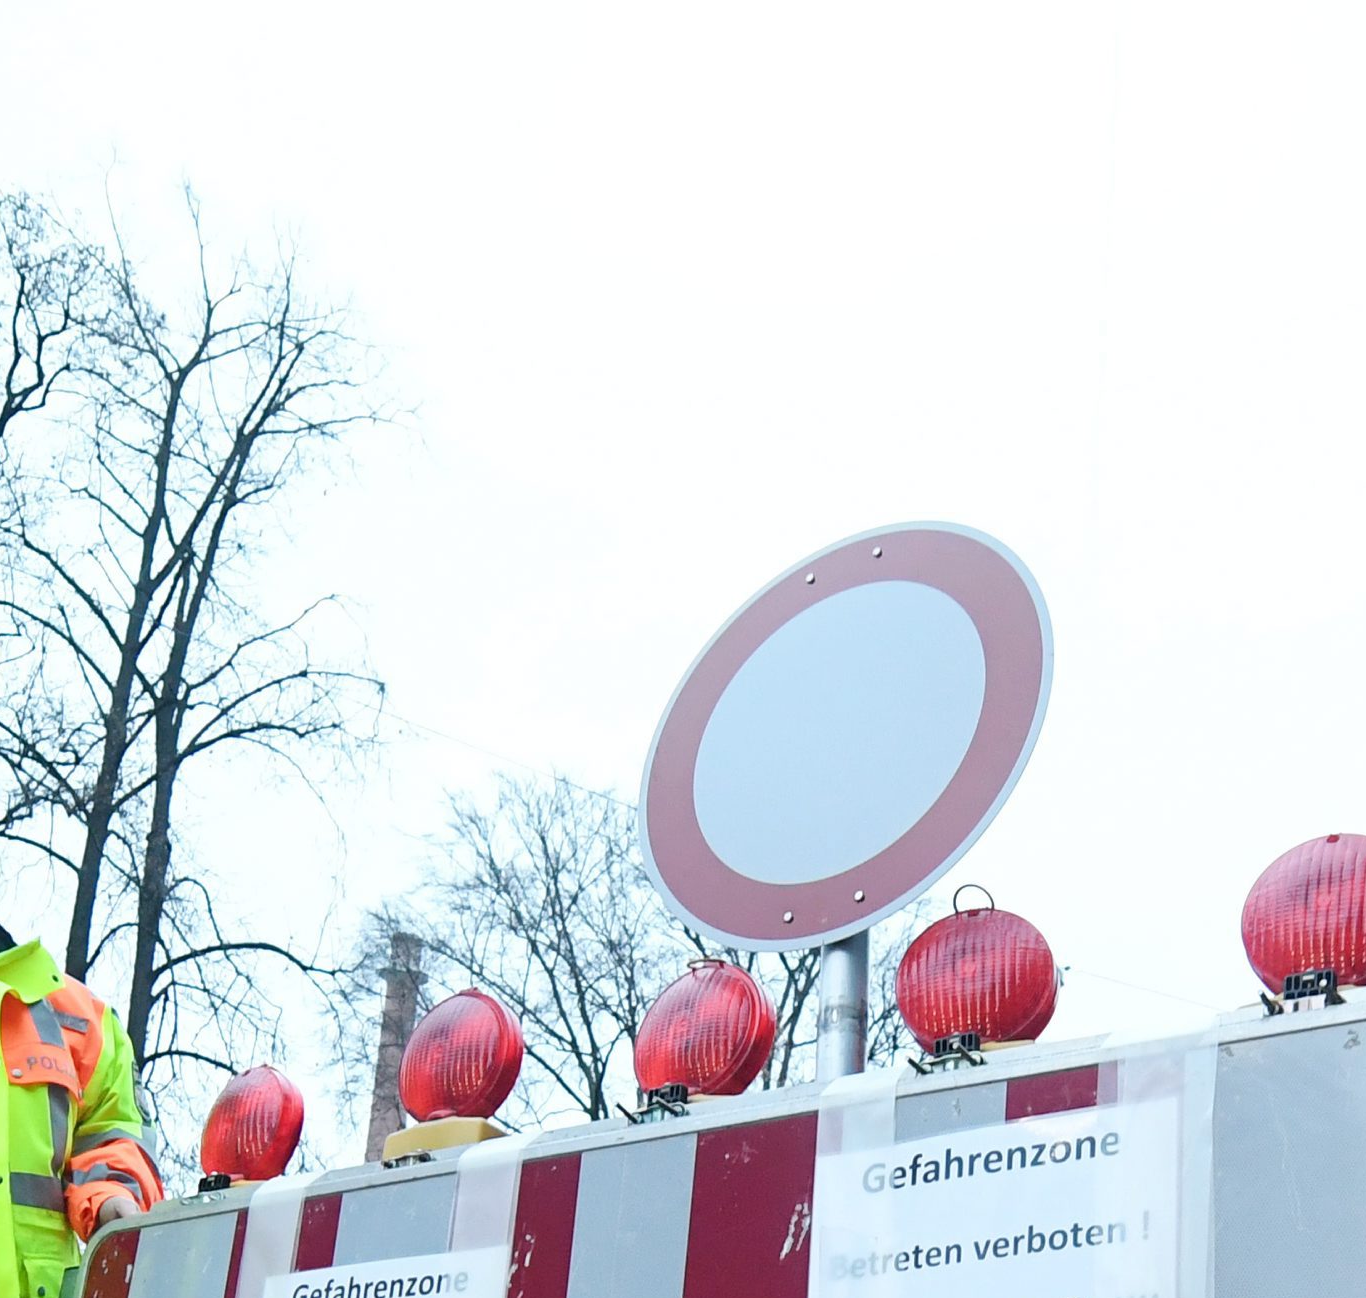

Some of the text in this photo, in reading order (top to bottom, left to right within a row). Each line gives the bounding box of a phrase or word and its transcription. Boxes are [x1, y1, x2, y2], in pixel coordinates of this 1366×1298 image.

[862, 1131, 1120, 1193] Gefahrenzone
[830, 1209, 1150, 1281] Betreten verboten !
